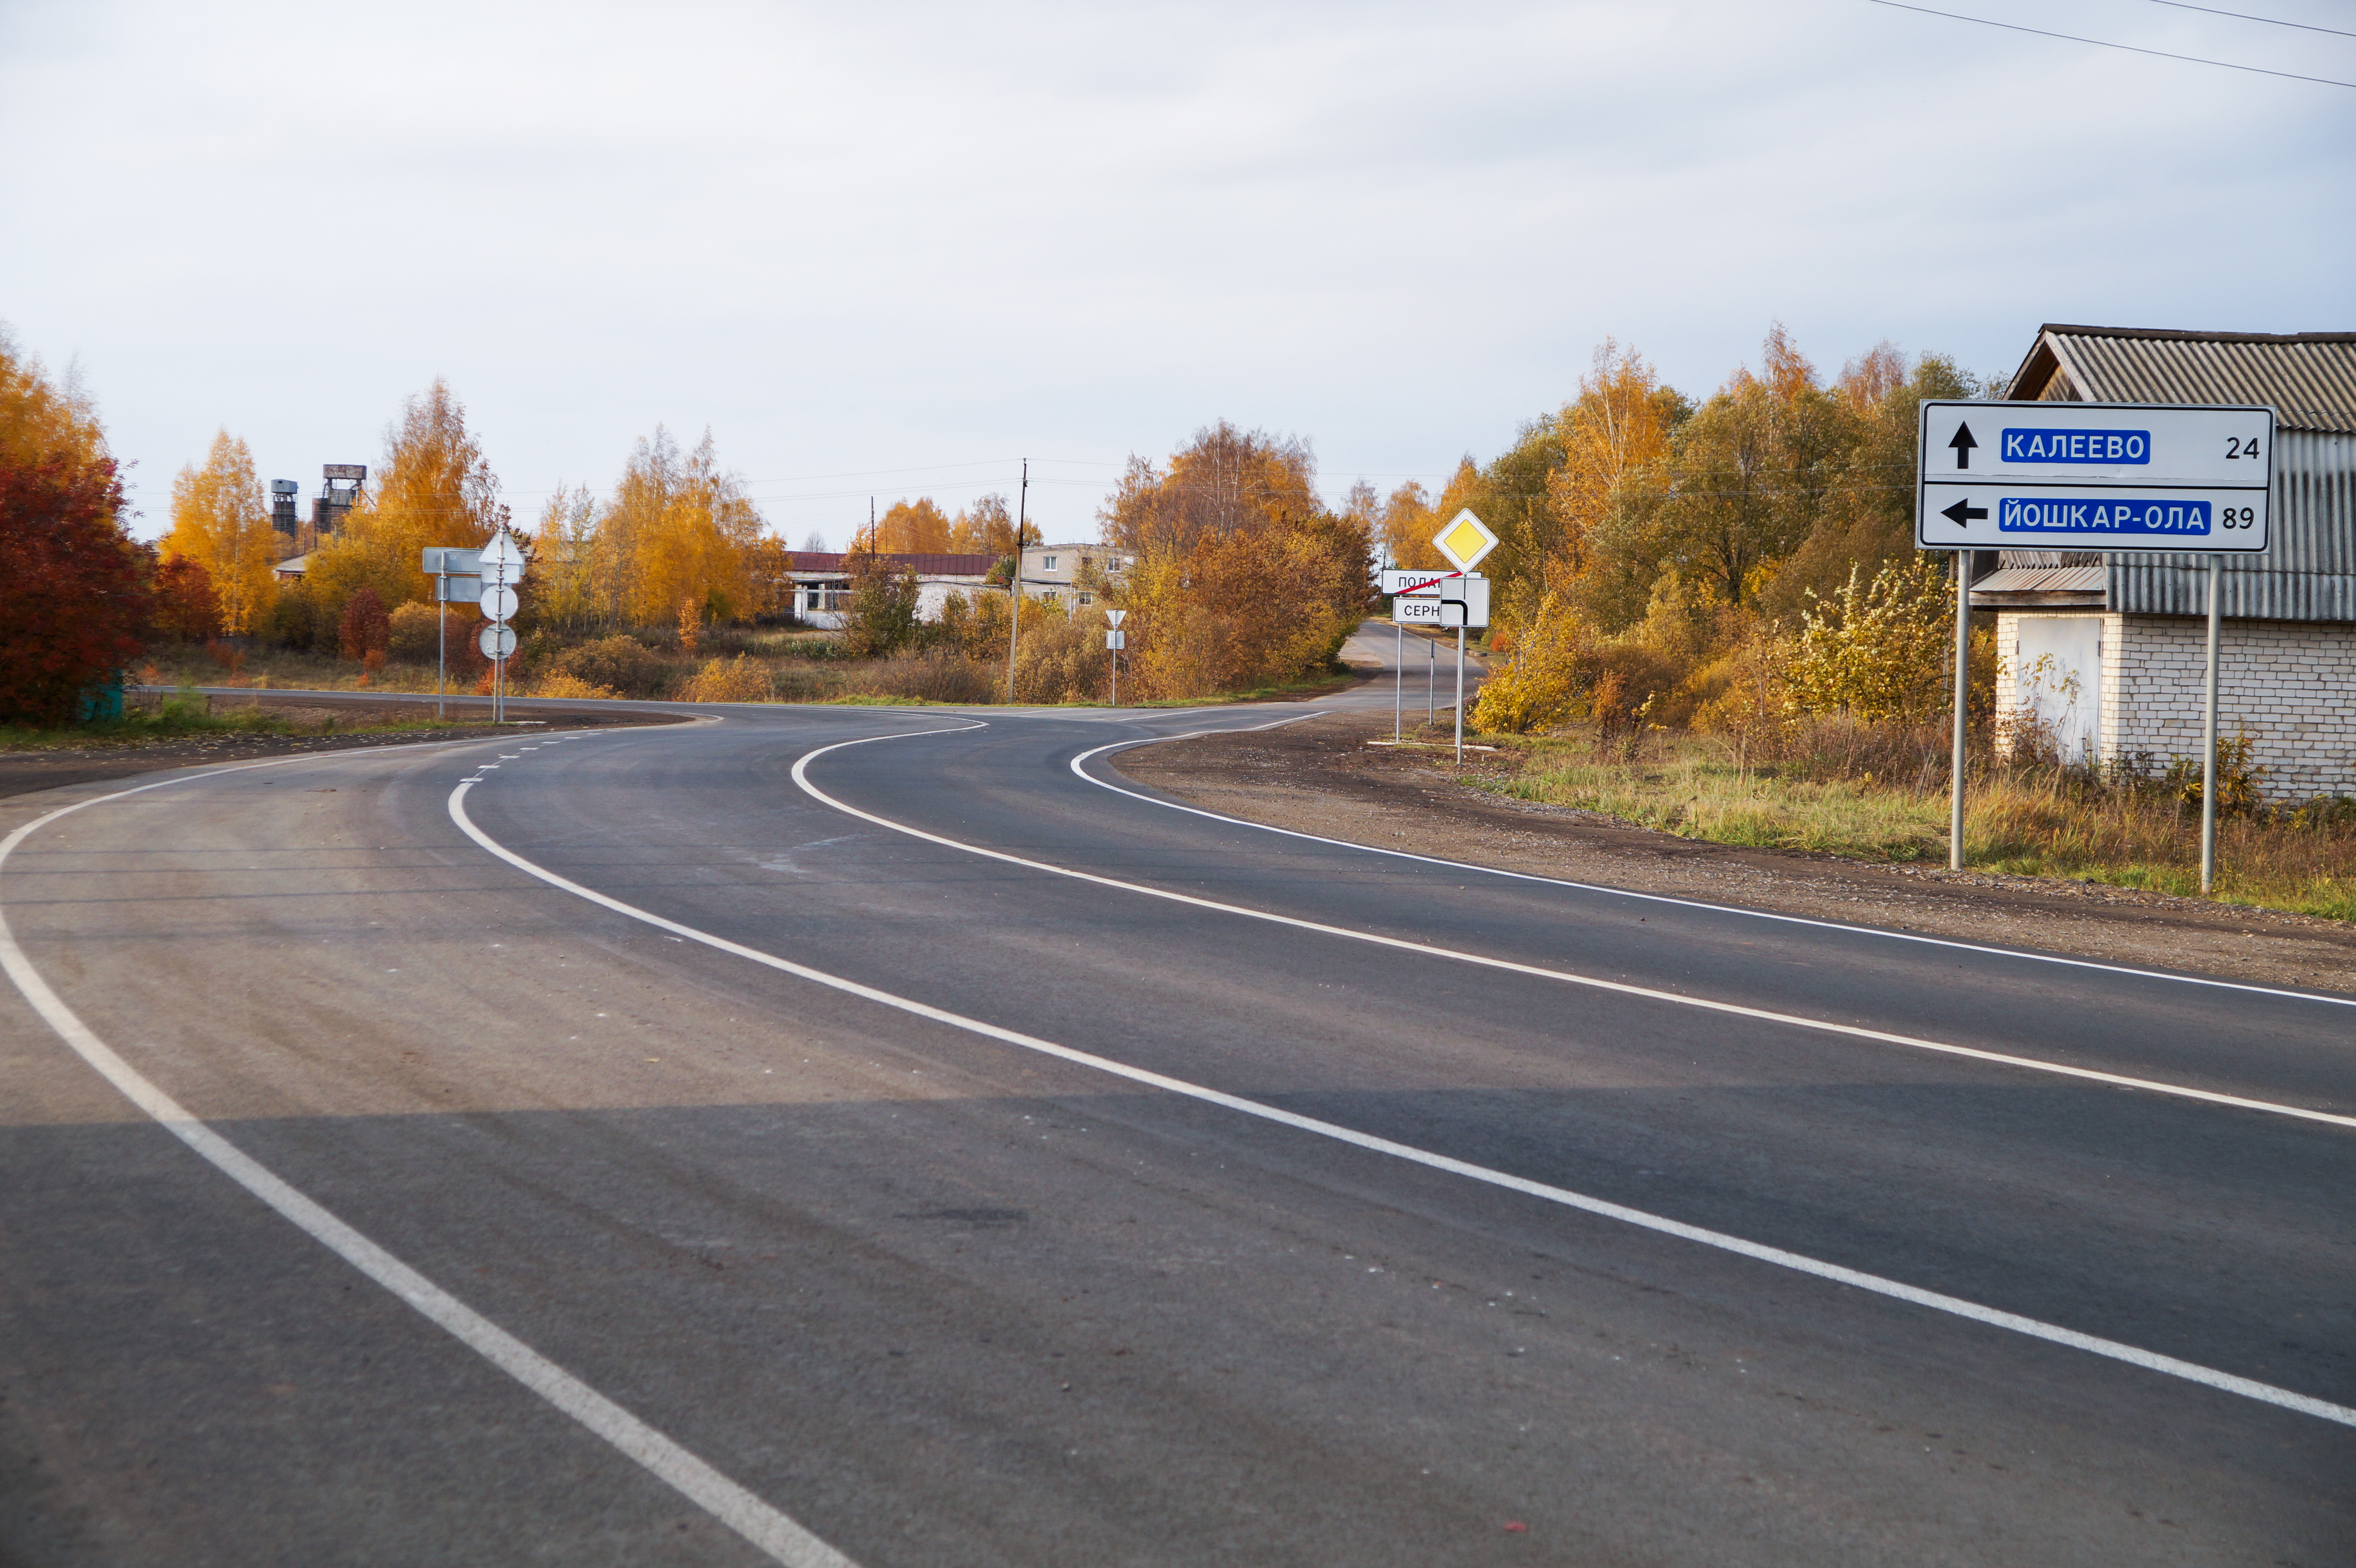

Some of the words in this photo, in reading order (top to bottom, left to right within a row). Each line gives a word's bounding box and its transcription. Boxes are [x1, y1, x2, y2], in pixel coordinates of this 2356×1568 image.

[2007, 434, 2144, 458] КАЛЕЕВО
[2226, 437, 2260, 459] 24
[2004, 499, 2205, 529] ЙОШКАР-ОЛА
[2223, 507, 2254, 530] 89
[1399, 577, 1441, 588] ПОЛА
